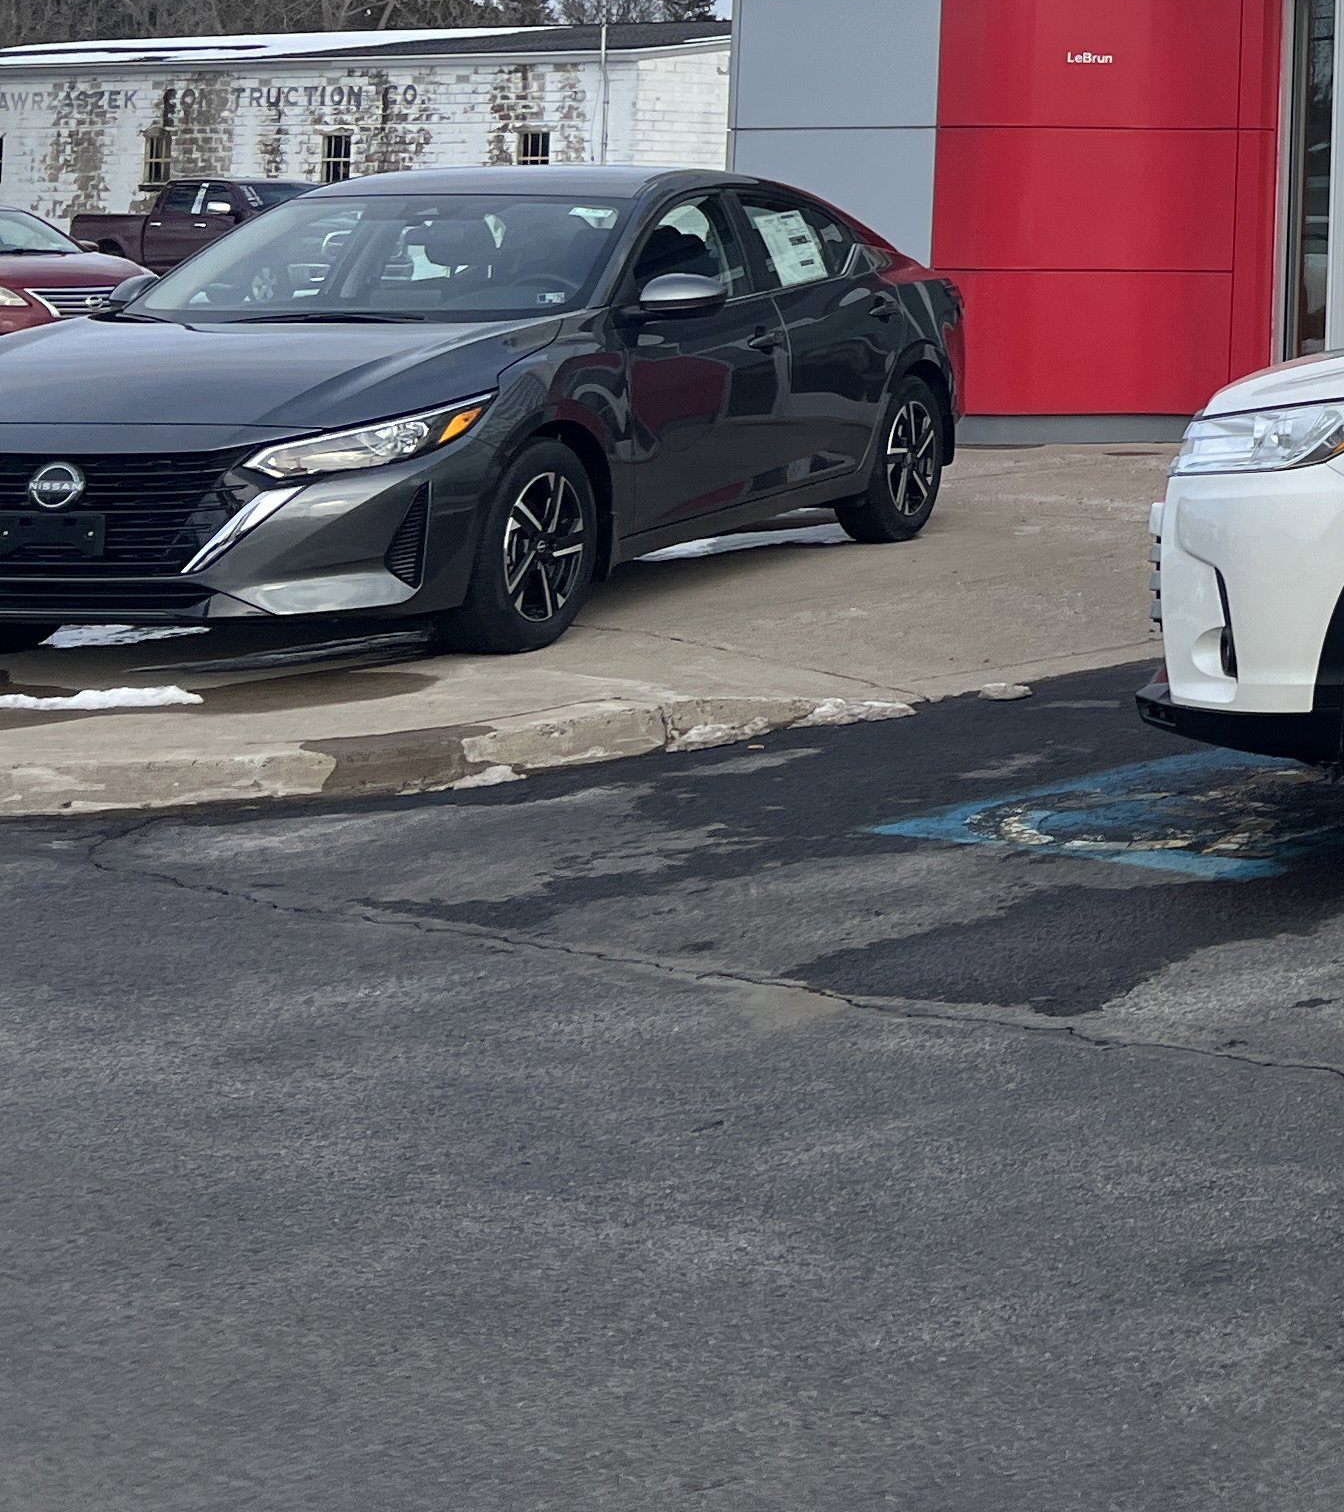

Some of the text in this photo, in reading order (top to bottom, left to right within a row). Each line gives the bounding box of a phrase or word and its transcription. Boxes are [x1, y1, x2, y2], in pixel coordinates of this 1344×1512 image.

[1067, 51, 1113, 64] LeBrun
[163, 85, 363, 110] CONTRUCTION
[28, 482, 82, 491] NISSAN
